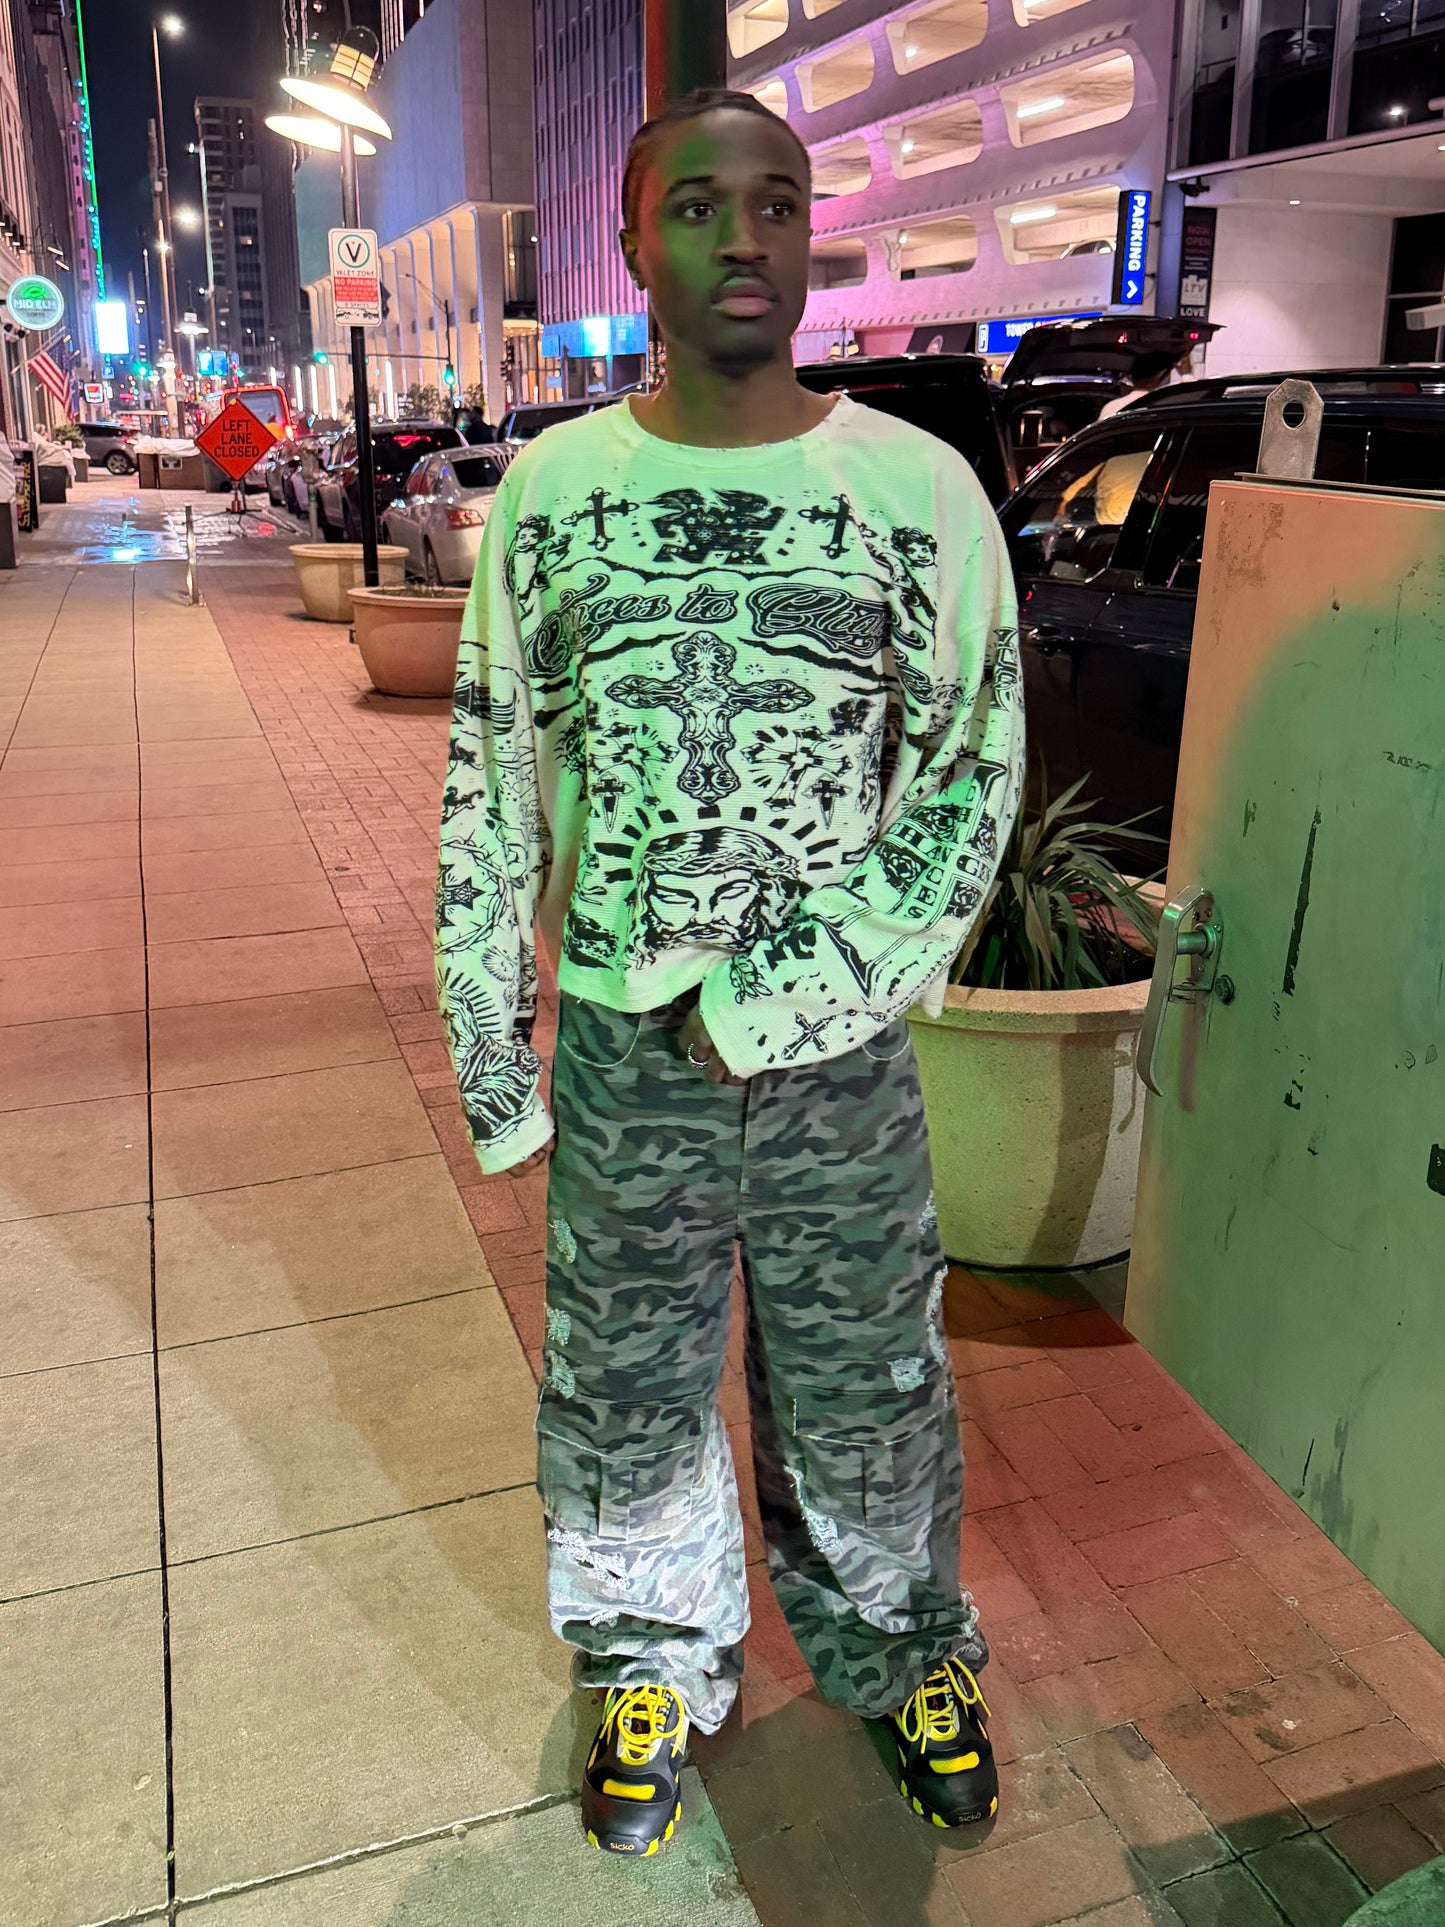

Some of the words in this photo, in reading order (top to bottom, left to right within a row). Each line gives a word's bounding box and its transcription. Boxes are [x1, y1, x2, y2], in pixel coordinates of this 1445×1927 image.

[1128, 194, 1146, 271] PARKING
[1185, 236, 1210, 246] OPEN
[345, 242, 361, 263] V
[335, 278, 346, 287] NO
[346, 278, 377, 288] PARKING
[1180, 307, 1206, 318] LOVE
[222, 420, 249, 432] LEFT
[221, 433, 252, 445] LANE
[213, 446, 259, 458] CLOSED
